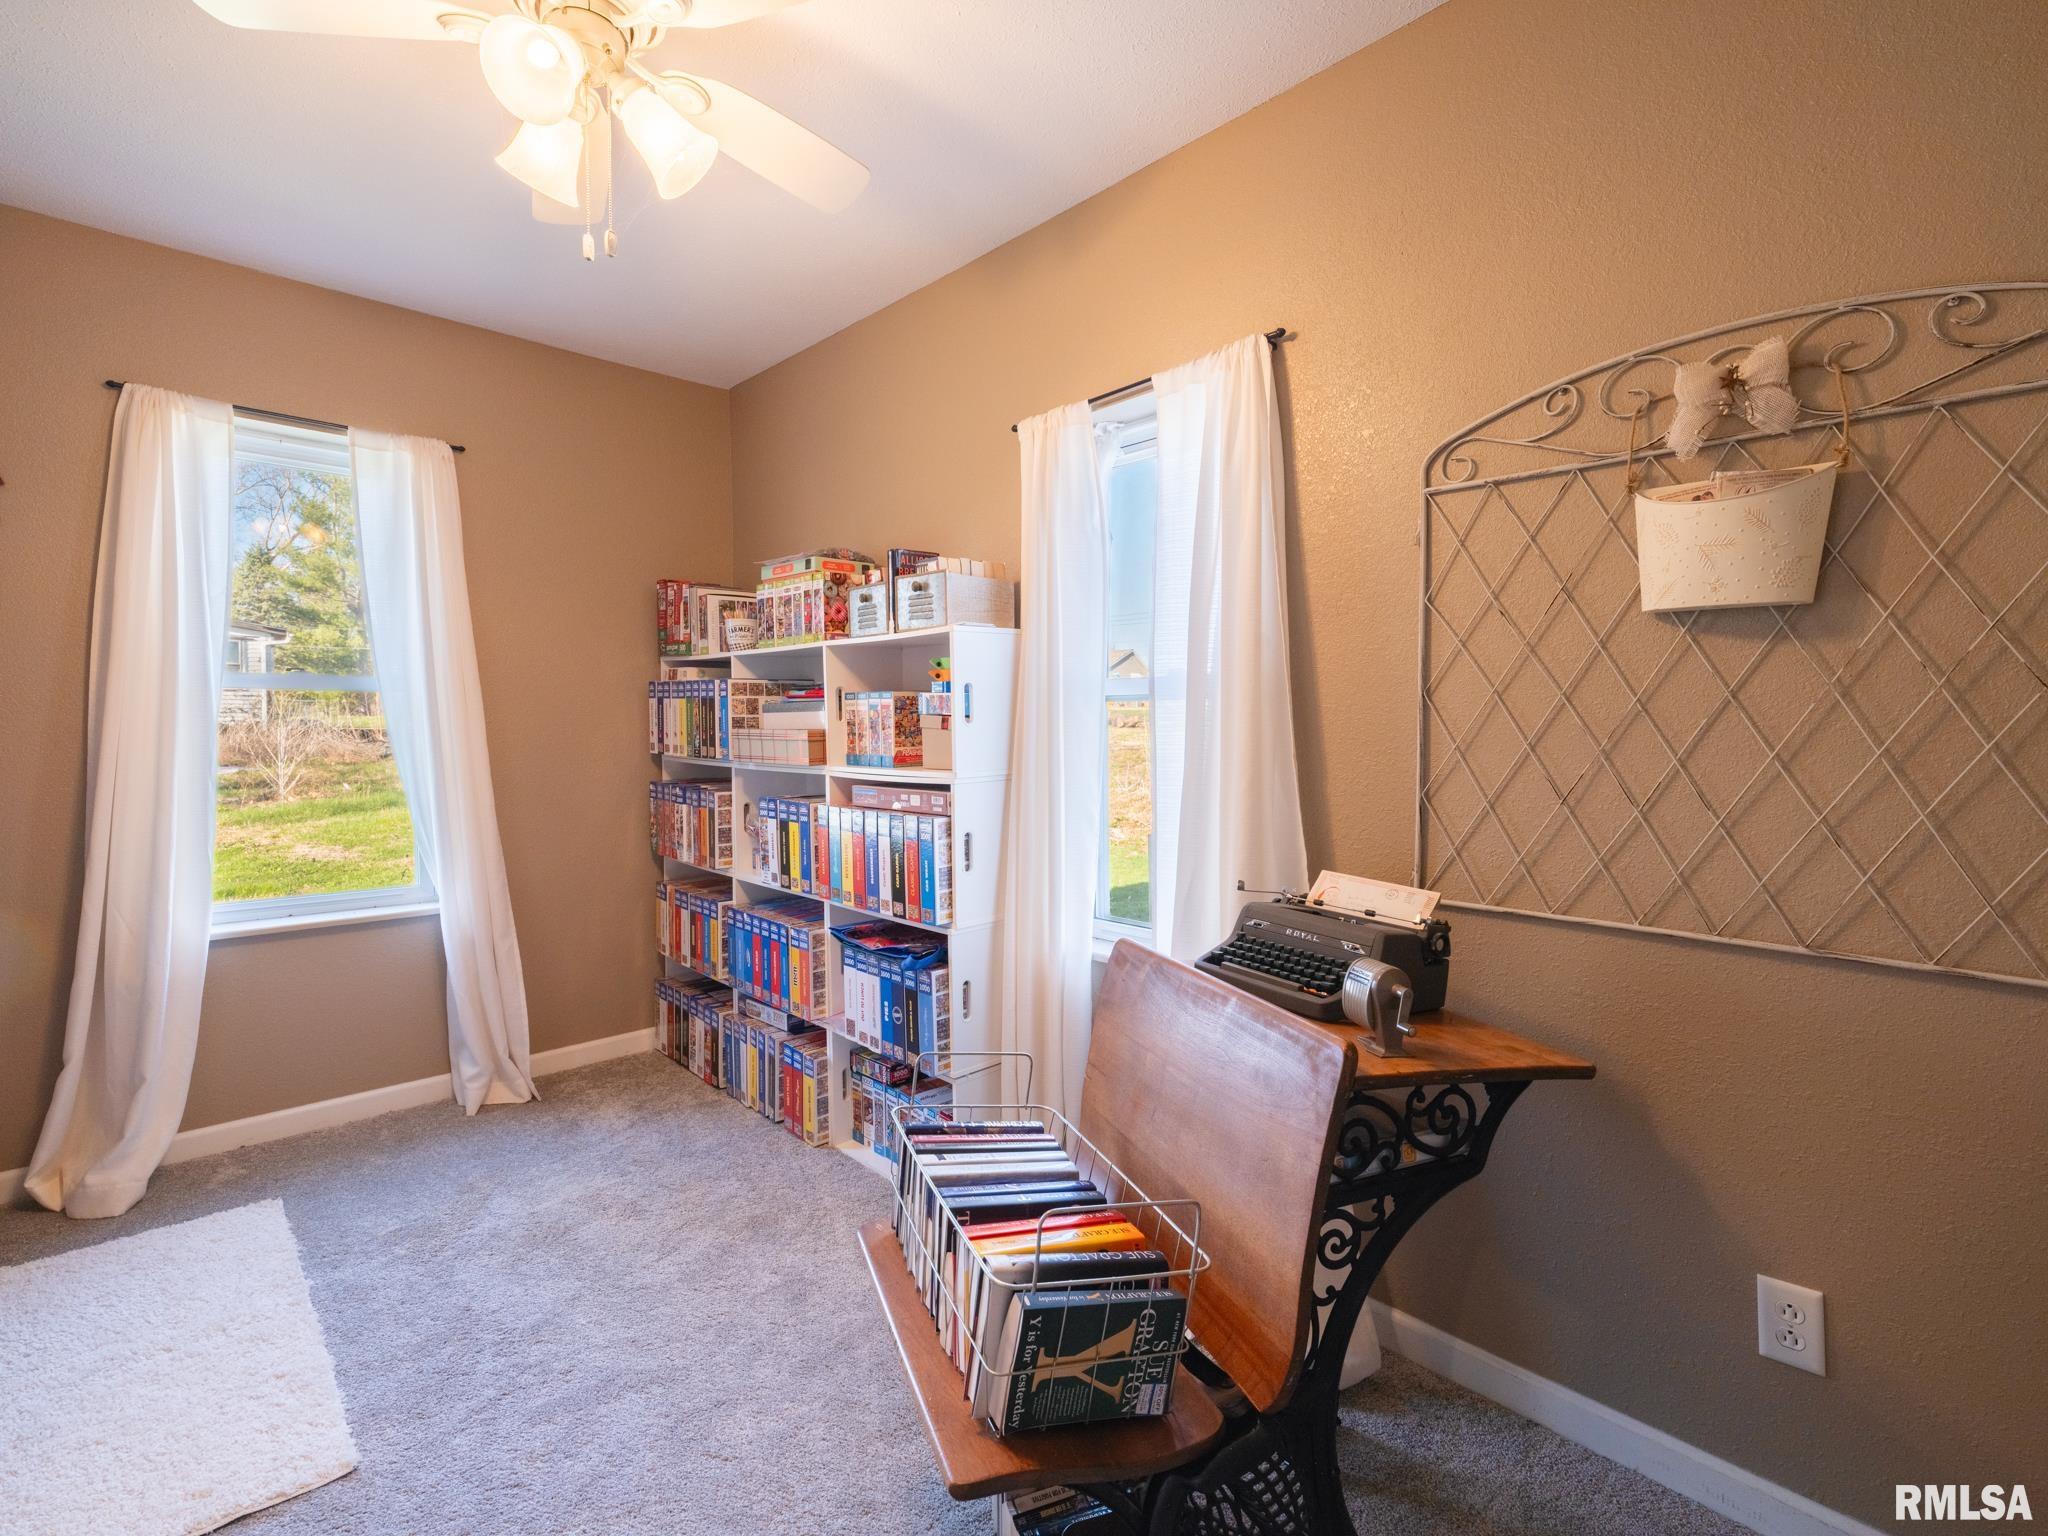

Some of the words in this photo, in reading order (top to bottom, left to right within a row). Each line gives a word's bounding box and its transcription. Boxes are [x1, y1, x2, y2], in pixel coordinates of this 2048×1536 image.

[1285, 928, 1320, 943] ROYAL
[1127, 1250, 1156, 1260] SUE
[1029, 1315, 1043, 1327] Y
[1026, 1330, 1040, 1342] is
[1022, 1344, 1038, 1363] for
[1121, 1307, 1158, 1414] GRAFTON
[1145, 1340, 1169, 1381] SUE
[1008, 1364, 1034, 1429] Yesterday
